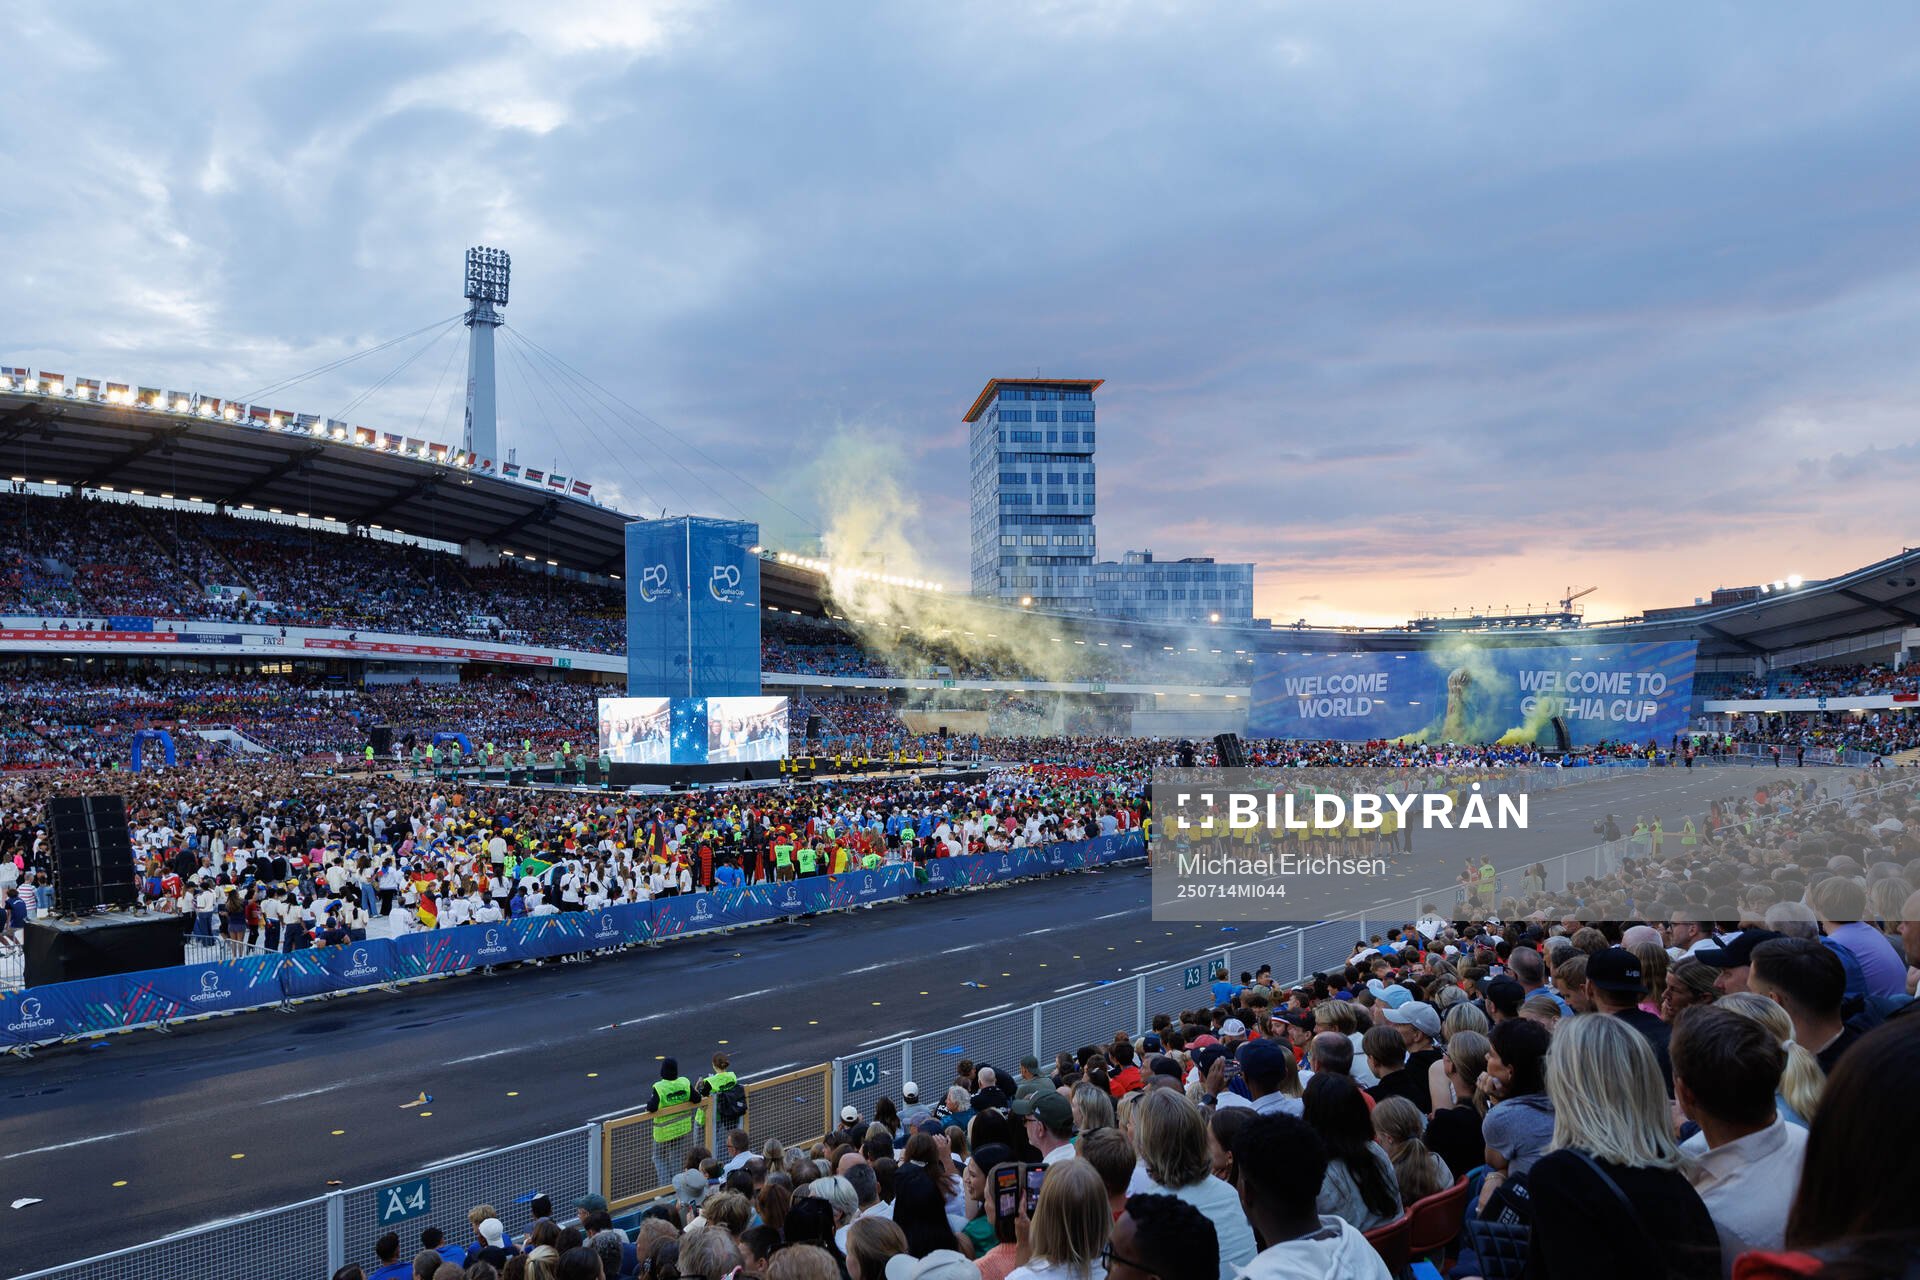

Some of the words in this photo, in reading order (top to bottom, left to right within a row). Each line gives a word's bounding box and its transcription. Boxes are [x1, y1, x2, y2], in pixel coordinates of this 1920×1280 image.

[1285, 673, 1388, 696] WELCOME
[1519, 671, 1632, 694] WELCOME
[1636, 672, 1667, 696] TO
[1298, 697, 1372, 718] WORLD
[1609, 700, 1658, 722] CUP
[1186, 968, 1200, 986] Ä3
[852, 1062, 875, 1087] Ä3
[384, 1183, 425, 1220] Ä4
